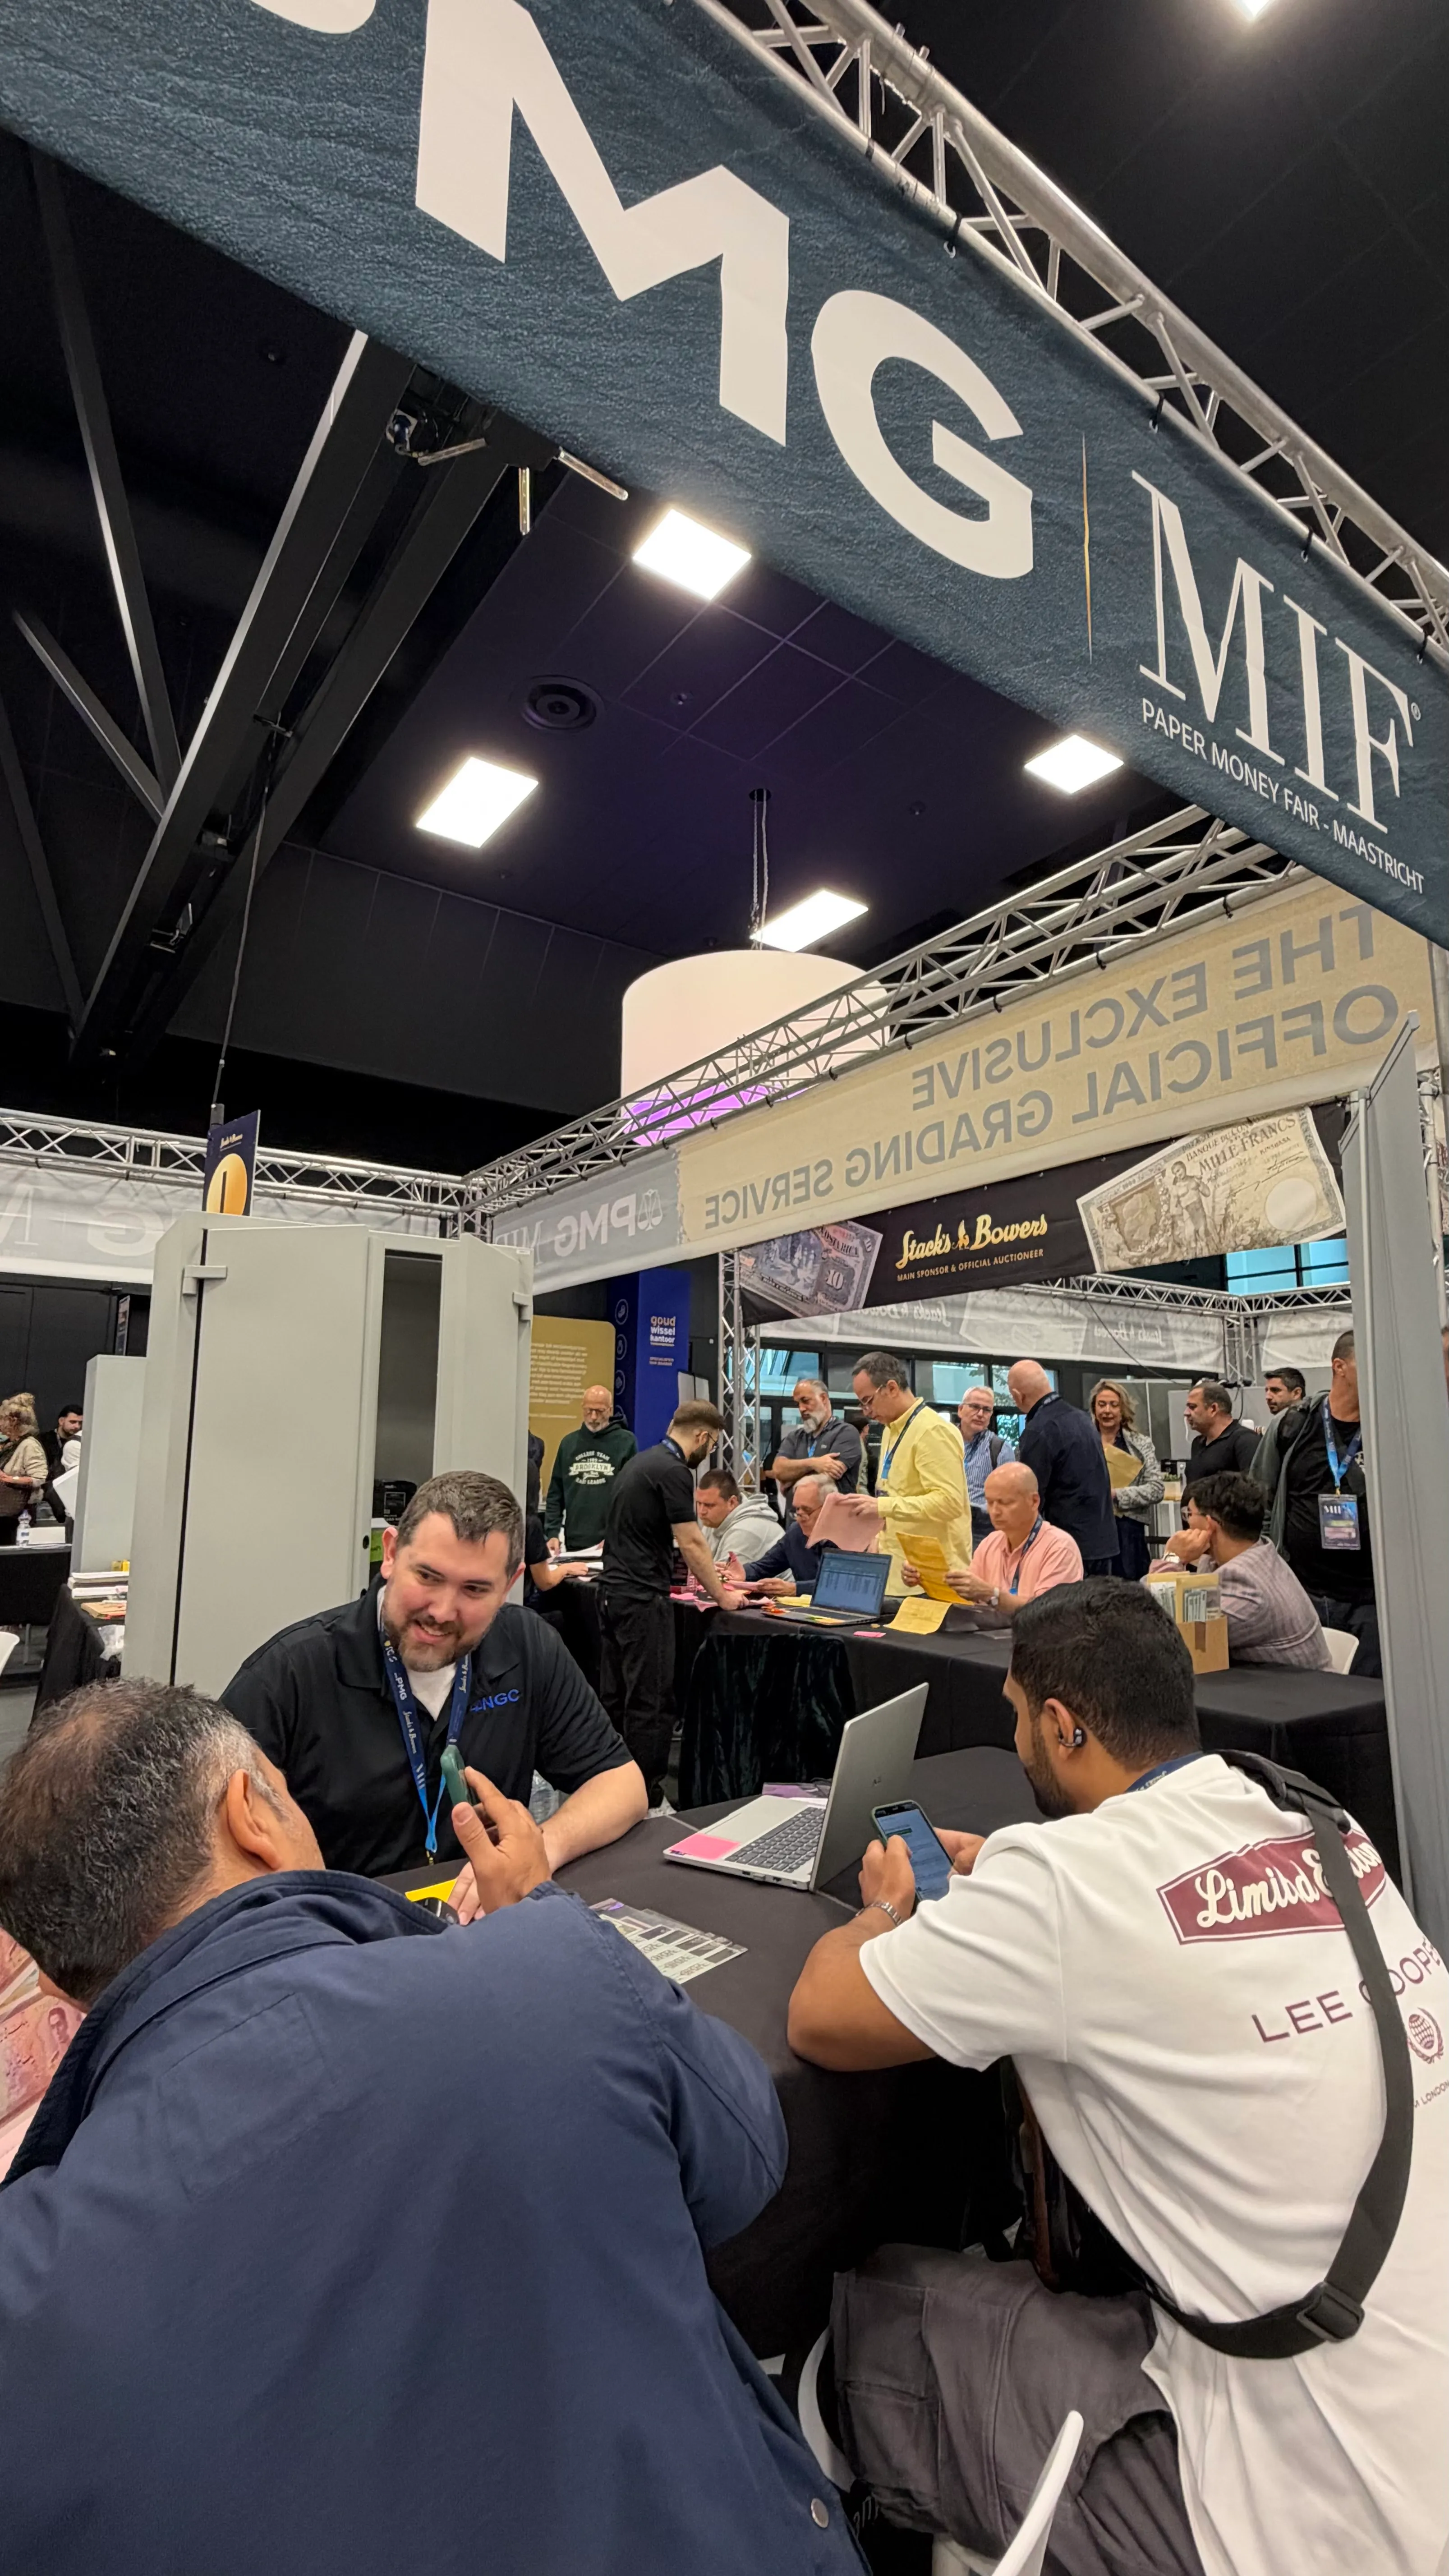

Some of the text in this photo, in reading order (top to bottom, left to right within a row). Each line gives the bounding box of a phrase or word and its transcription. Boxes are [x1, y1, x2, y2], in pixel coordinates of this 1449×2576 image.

[253, 0, 1034, 579] MG
[1142, 698, 1207, 760] PAPER
[1212, 742, 1279, 804] MONEY
[1284, 788, 1320, 830] FAIR
[1334, 819, 1425, 894] MAASTRICHT
[1241, 1110, 1296, 1151] FRANCS
[895, 1224, 952, 1270] Stack's
[970, 1214, 1048, 1251] Bowers
[897, 1248, 1044, 1282] MAIN SPONSOR & OFFICIAL AUCTIONEER
[826, 1269, 844, 1290] 10
[650, 1316, 676, 1327] goud
[650, 1325, 676, 1335] wissel
[650, 1334, 675, 1343] kantoor
[395, 1677, 407, 1700] PMG
[482, 1688, 520, 1711] NGC
[1251, 1990, 1353, 2043] LEE
